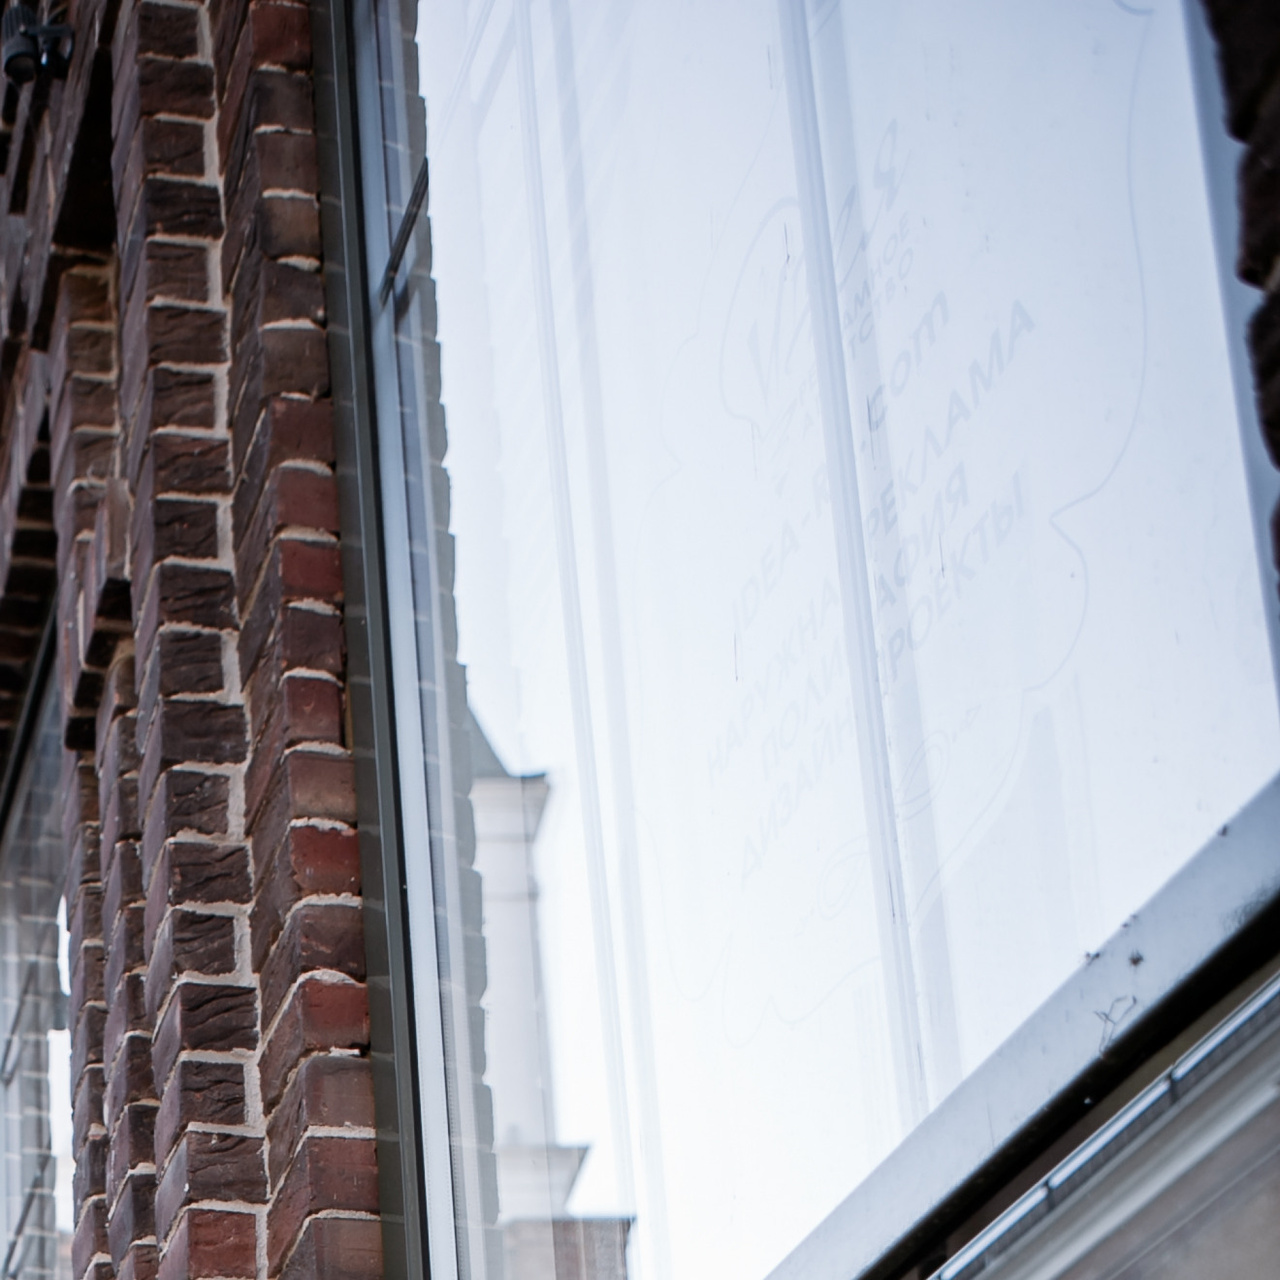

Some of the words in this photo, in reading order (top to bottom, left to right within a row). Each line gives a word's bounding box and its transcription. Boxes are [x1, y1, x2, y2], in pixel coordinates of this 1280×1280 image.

[731, 290, 950, 648] IDEA-R.com
[885, 471, 1025, 682] РОЕКТЫ
[707, 577, 840, 790] НАРУЖНА
[760, 461, 969, 782] ПОЛИАФИЯ
